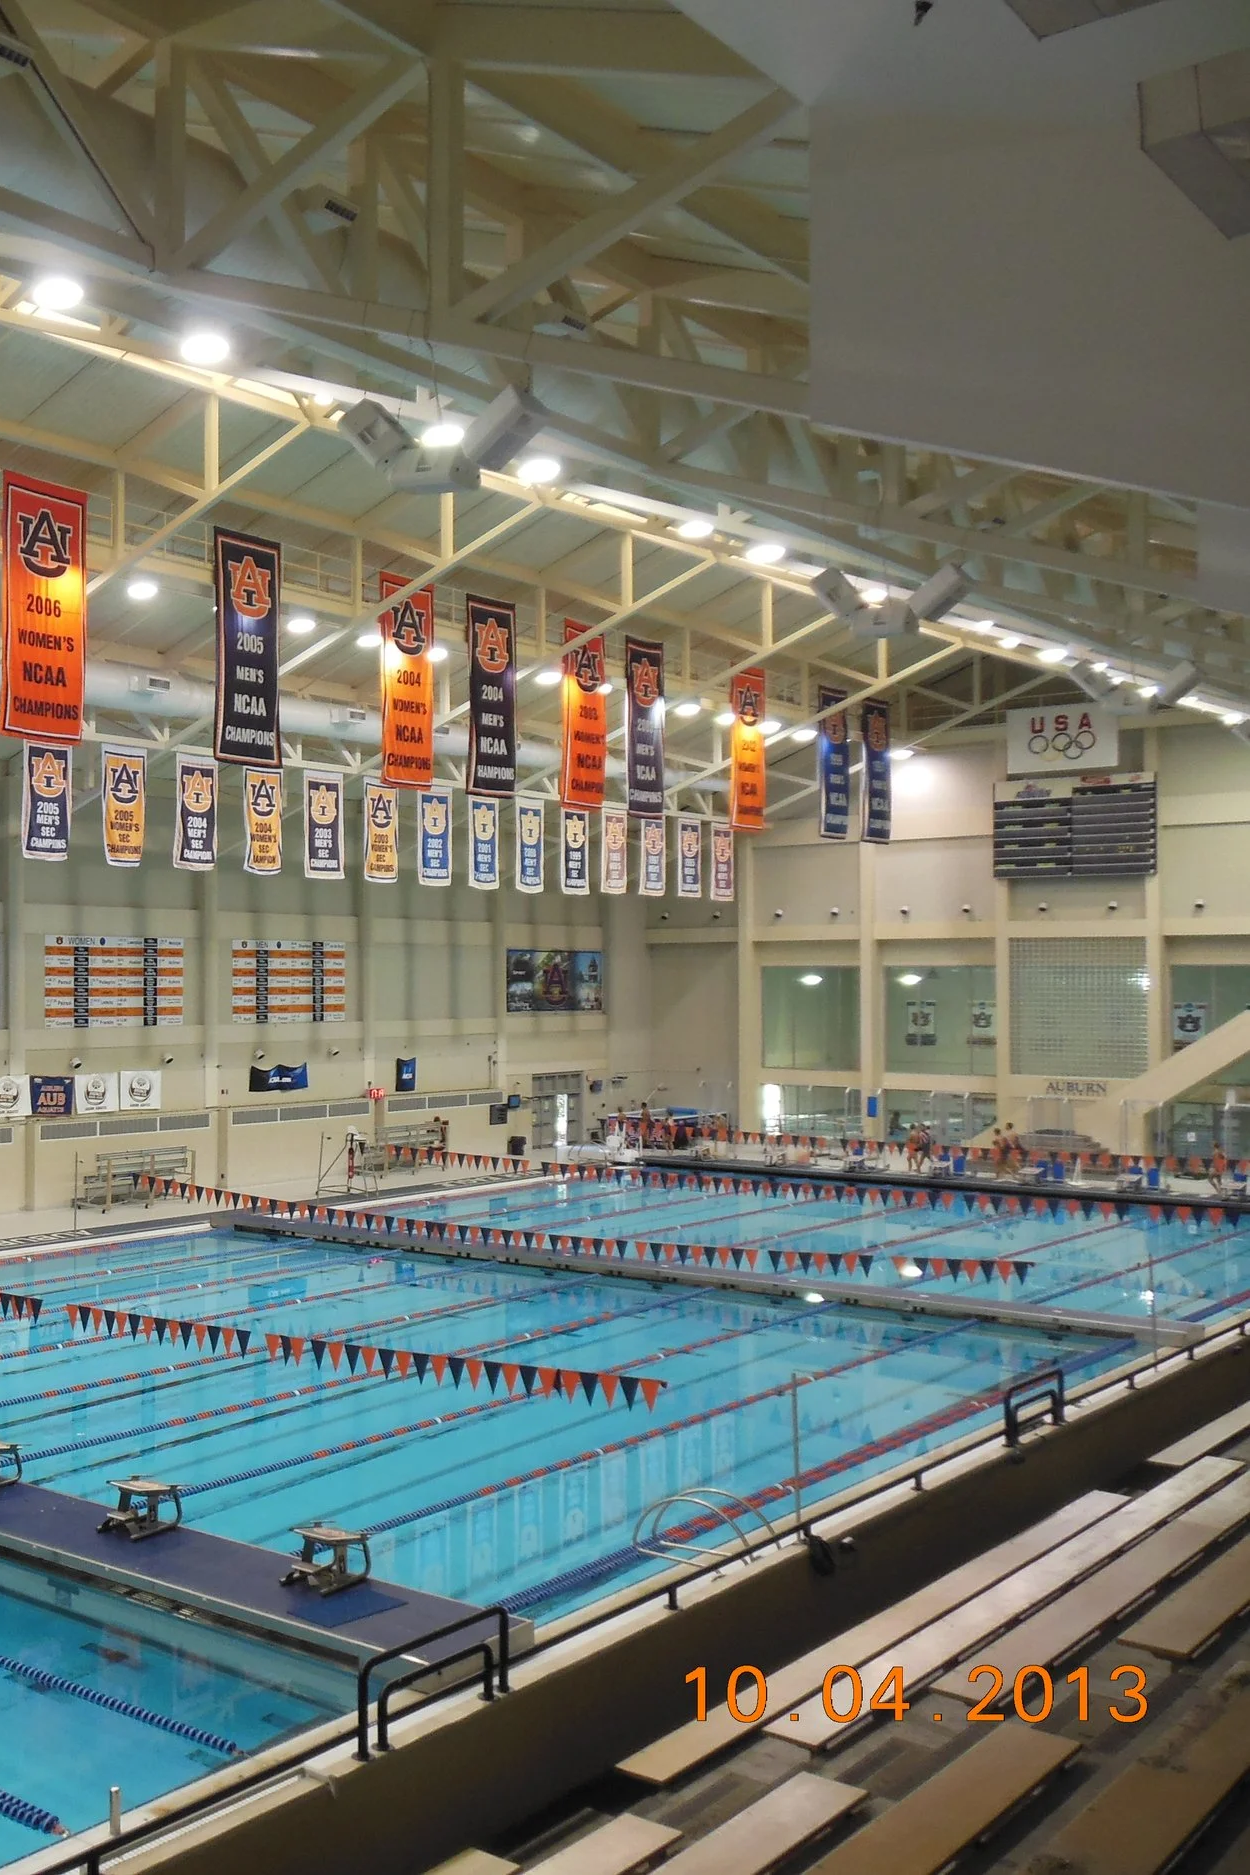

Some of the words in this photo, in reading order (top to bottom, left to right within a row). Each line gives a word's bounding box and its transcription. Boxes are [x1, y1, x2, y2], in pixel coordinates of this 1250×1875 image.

[26, 593, 61, 618] 2006
[18, 628, 74, 652] WOMEN'S
[237, 632, 263, 654] 2005
[22, 660, 66, 688] NCAA
[236, 665, 264, 684] MEN'S
[397, 669, 421, 687] 2004
[482, 684, 503, 702] 2004
[13, 696, 78, 720] CHAMPIONS
[234, 694, 266, 717] NCAA
[393, 698, 427, 715] WOMEN'S
[482, 713, 504, 728] MEN'S
[225, 724, 275, 747] CHAMPIONS
[396, 724, 423, 744] NCAA
[481, 736, 507, 756] NCAA
[37, 801, 59, 815] 2005
[114, 810, 133, 821] 2005
[36, 814, 60, 826] MEN'S
[255, 823, 272, 833] 2004
[41, 826, 56, 837] SEC
[118, 834, 130, 842] SEC
[31, 837, 66, 849] CHAMPIONS
[191, 840, 203, 849] SEC
[259, 844, 269, 853] SEC
[318, 849, 329, 858] SEC
[68, 937, 95, 945] WOMEN
[37, 1092, 66, 1106] AUB
